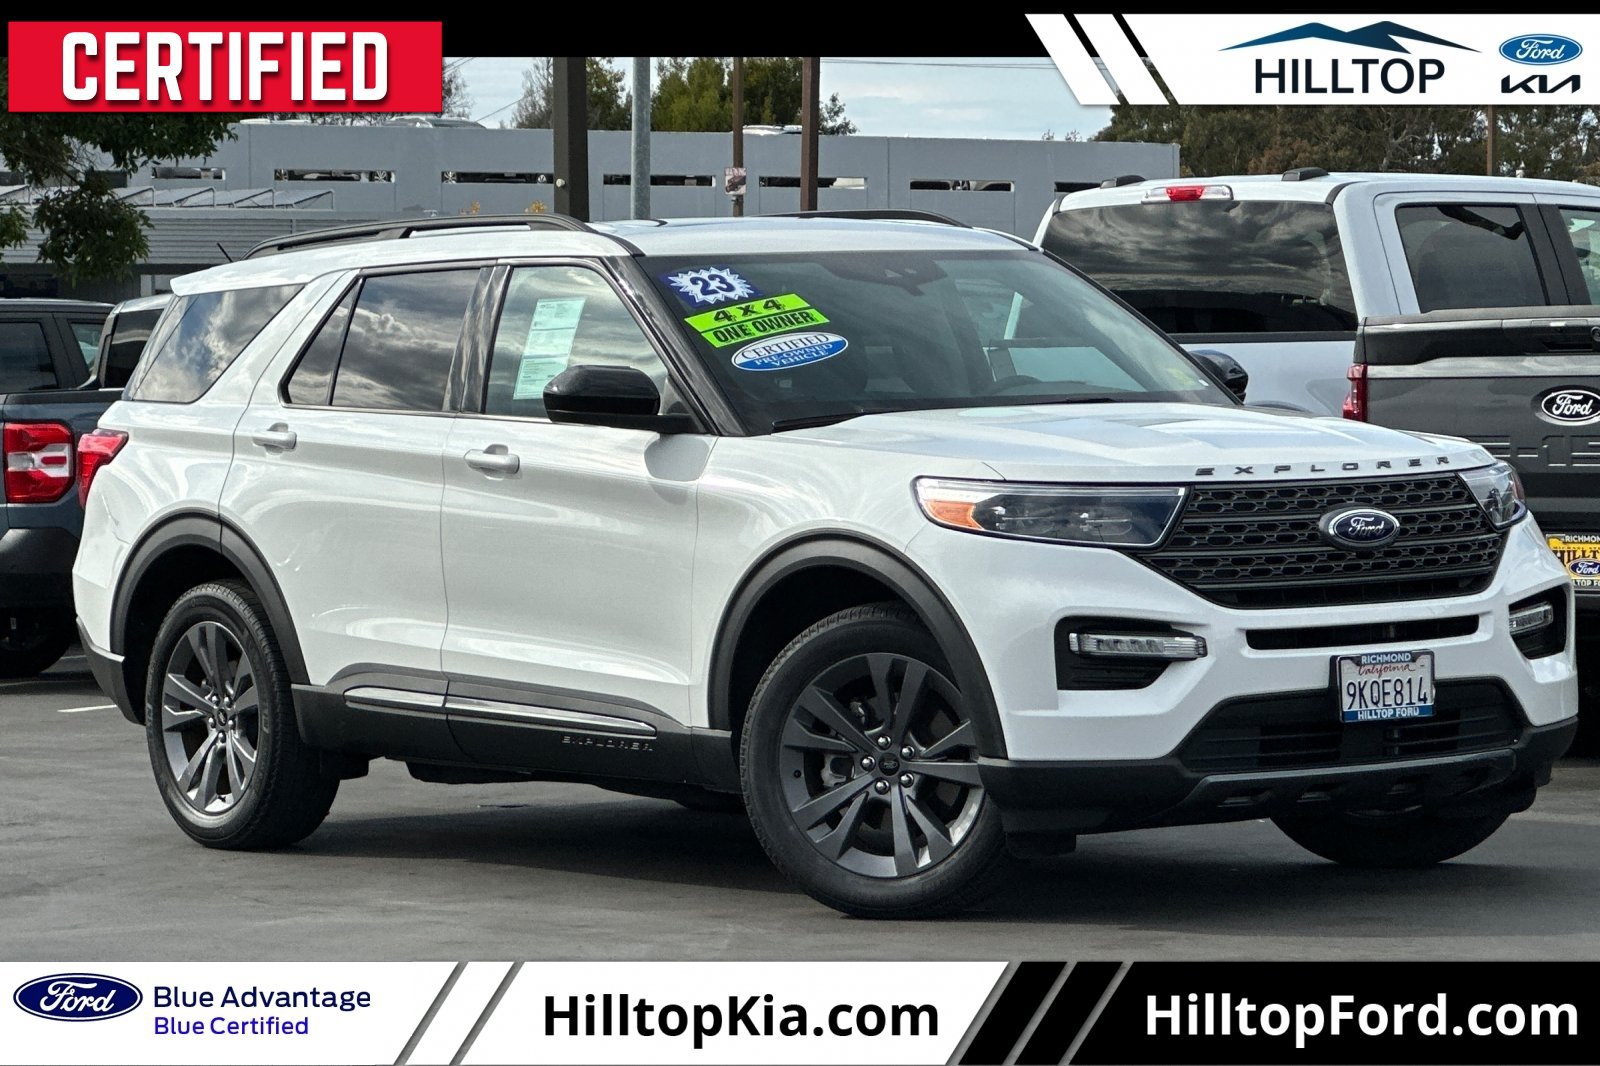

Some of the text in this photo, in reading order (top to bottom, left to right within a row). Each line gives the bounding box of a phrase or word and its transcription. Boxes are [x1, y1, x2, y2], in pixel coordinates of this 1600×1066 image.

[690, 273, 736, 296] 23
[712, 311, 817, 344] ONE OWNER
[741, 333, 830, 361] CERTIFIED
[754, 343, 833, 366] PRE-OWNED
[770, 350, 829, 368] VEHICLE
[1552, 394, 1594, 416] Ford
[1195, 456, 1449, 476] EXPLORER
[1348, 516, 1386, 536] Ford
[1576, 561, 1600, 574] Ford
[1361, 653, 1411, 664] RICHMOND
[1358, 663, 1415, 678] California
[1346, 676, 1428, 710] 9KQE814
[1357, 707, 1420, 720] HILLTOP FORD
